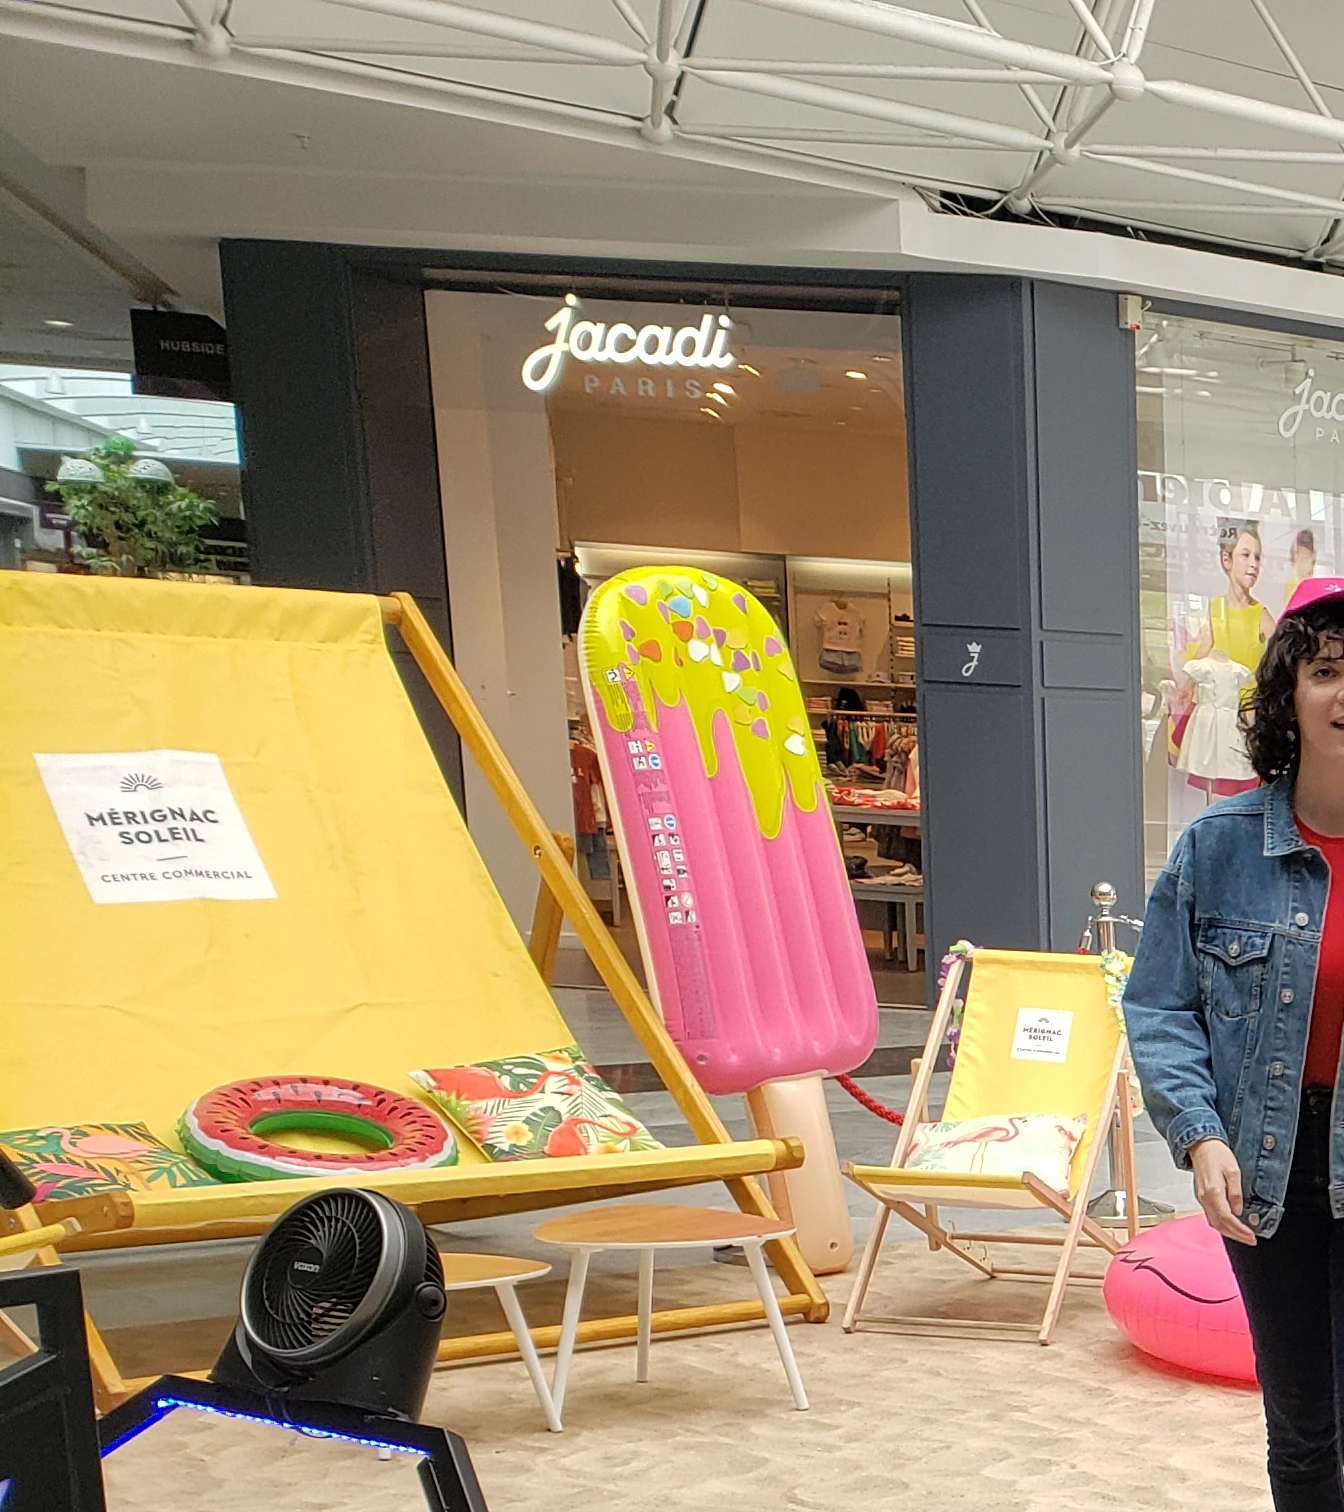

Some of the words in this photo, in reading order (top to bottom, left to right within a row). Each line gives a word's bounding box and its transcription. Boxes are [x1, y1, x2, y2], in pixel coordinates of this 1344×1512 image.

[160, 339, 225, 355] HUBSIDE
[521, 293, 735, 391] jacadi
[584, 374, 702, 399] PARIS
[84, 807, 220, 828] MÉRIGNAC
[118, 826, 206, 846] SOLEIL
[101, 872, 158, 884] CENTRE
[162, 868, 253, 880] COMMERCIAL
[1023, 1027, 1062, 1036] MÉRIGNAC
[1028, 1034, 1053, 1042] SOLEIL
